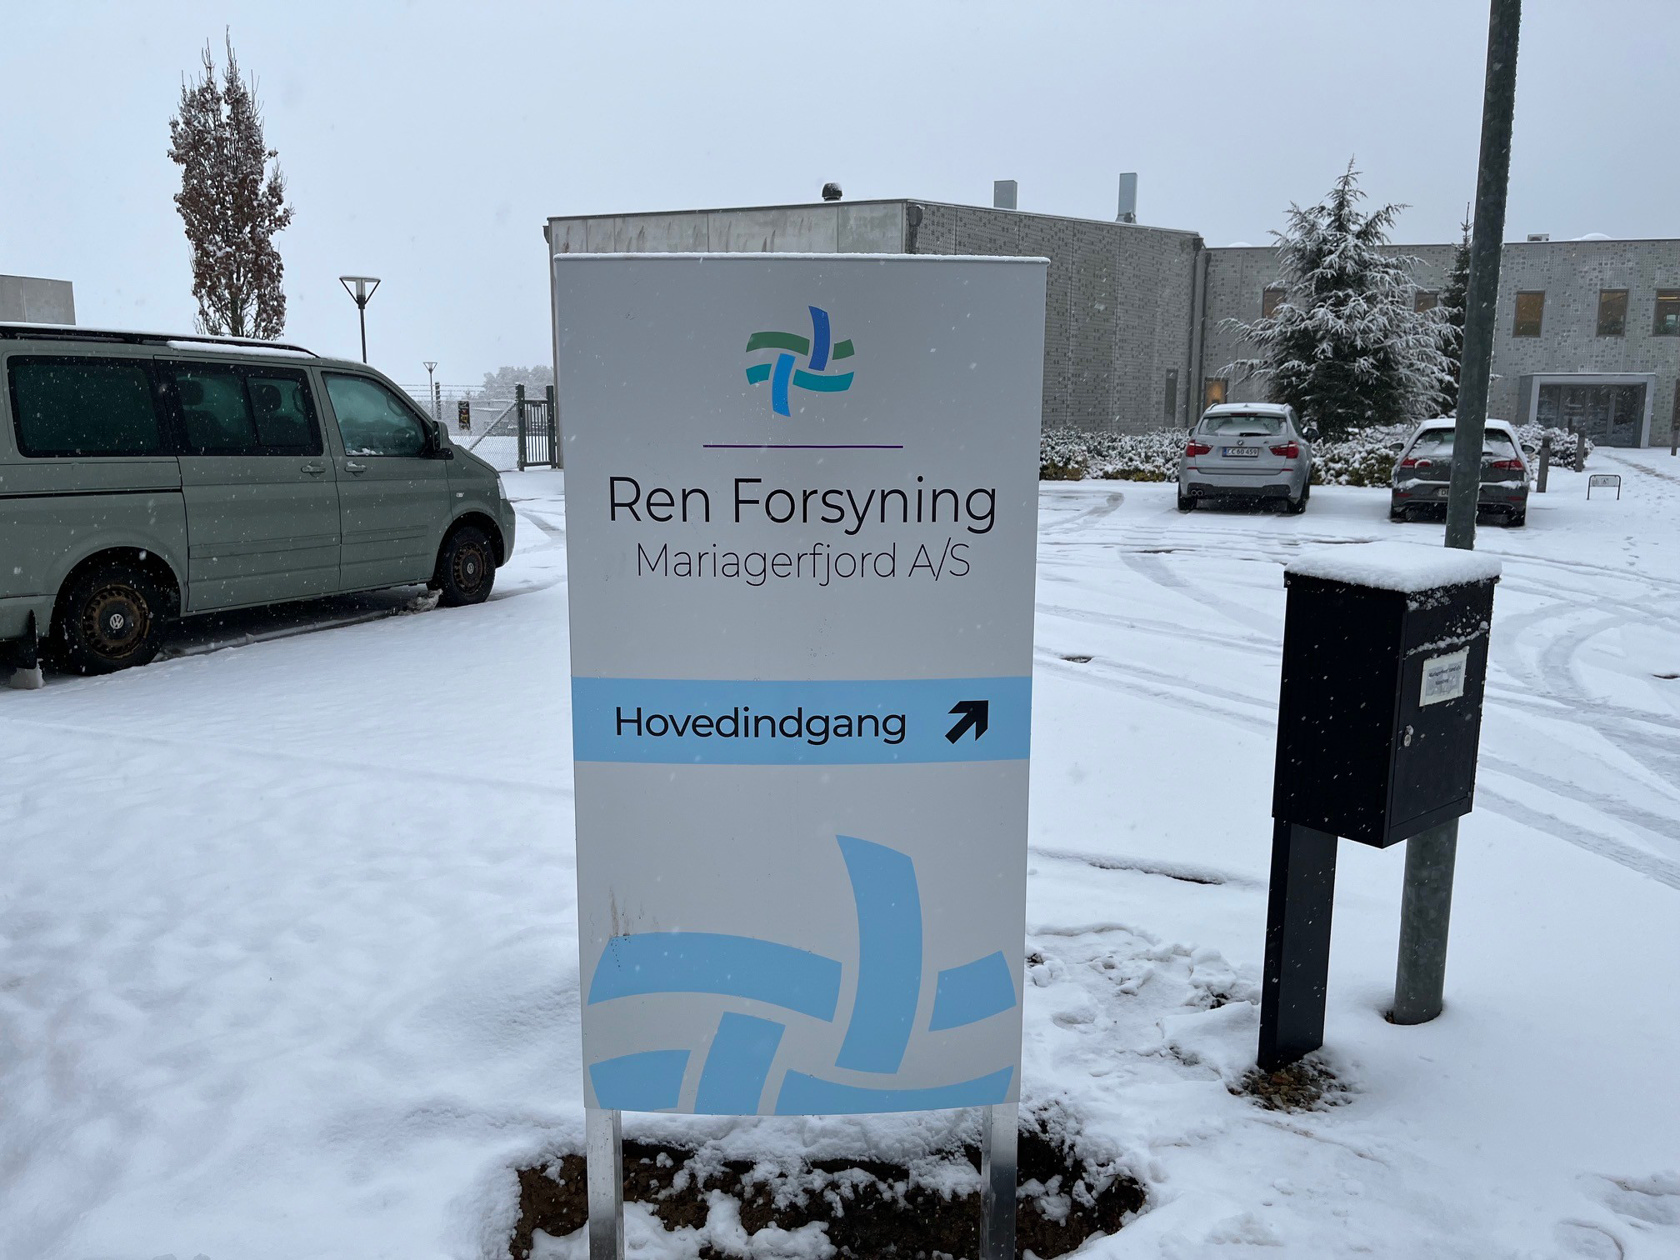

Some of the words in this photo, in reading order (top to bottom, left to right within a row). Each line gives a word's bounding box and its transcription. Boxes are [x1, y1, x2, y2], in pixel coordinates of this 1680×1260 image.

[609, 476, 710, 524] Ren
[734, 475, 996, 536] Forsyning
[637, 541, 896, 587] Mariagerfjord
[907, 536, 971, 582] A/S
[615, 705, 906, 746] Hovedindgang
